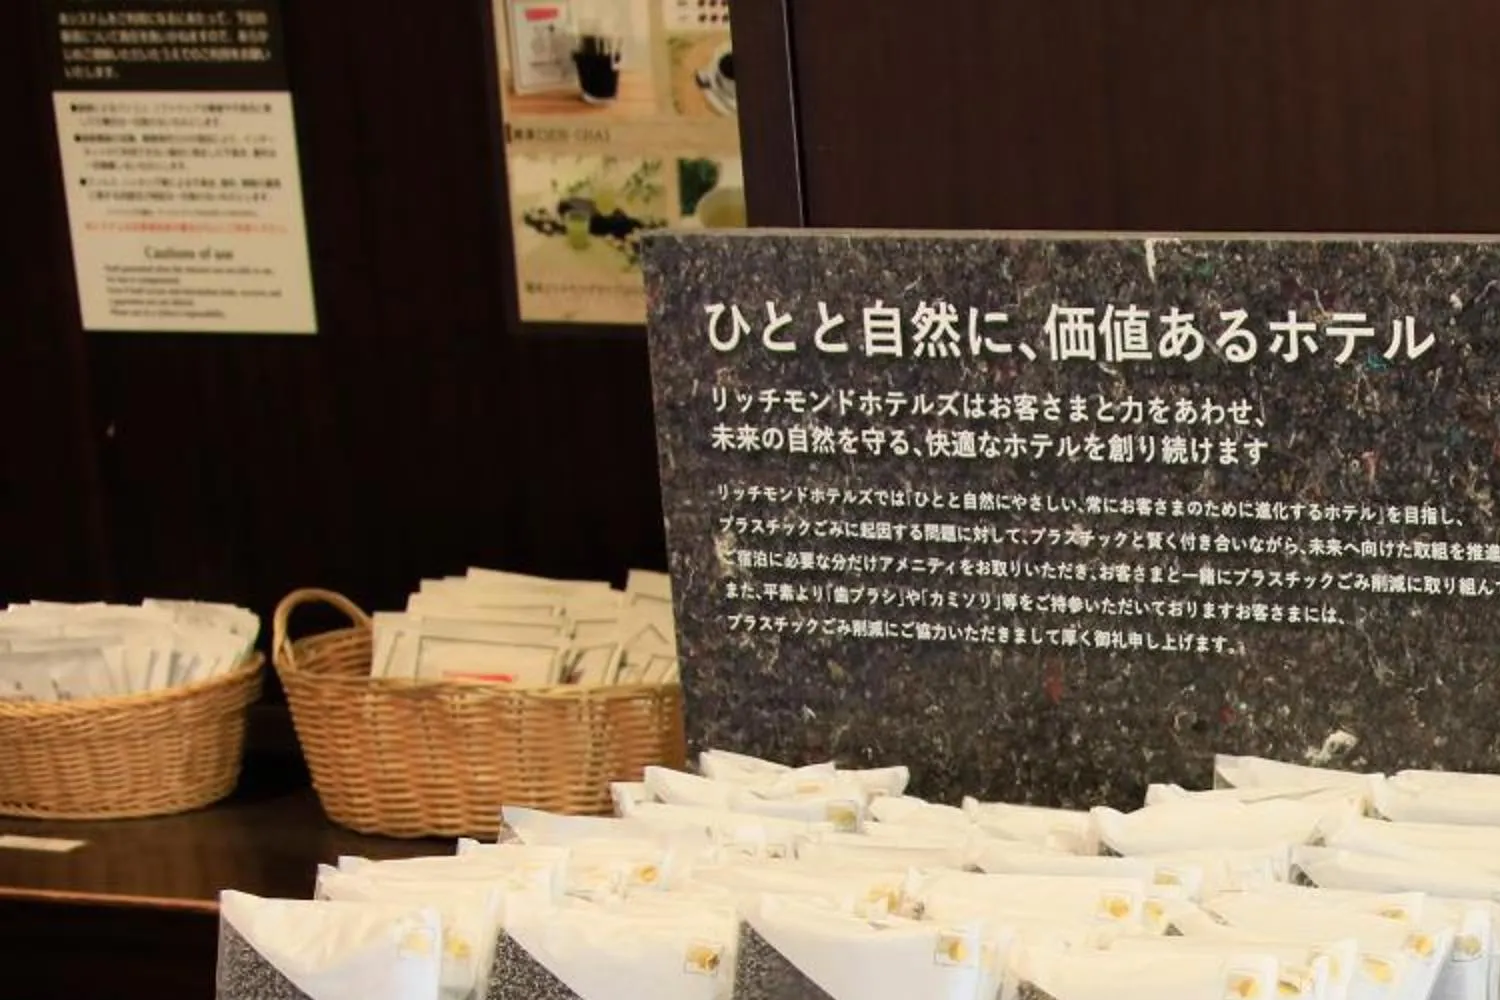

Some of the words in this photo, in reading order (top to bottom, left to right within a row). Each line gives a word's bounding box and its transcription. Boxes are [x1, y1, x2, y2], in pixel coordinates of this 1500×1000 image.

[705, 300, 1436, 363] ひとと自然に、価値あるホテル
[710, 386, 1267, 428] リッチモンドホテルズはお客さまと力をあわせ、
[711, 422, 1269, 466] 未来の自然を守る、快適なホテルを創り続けます
